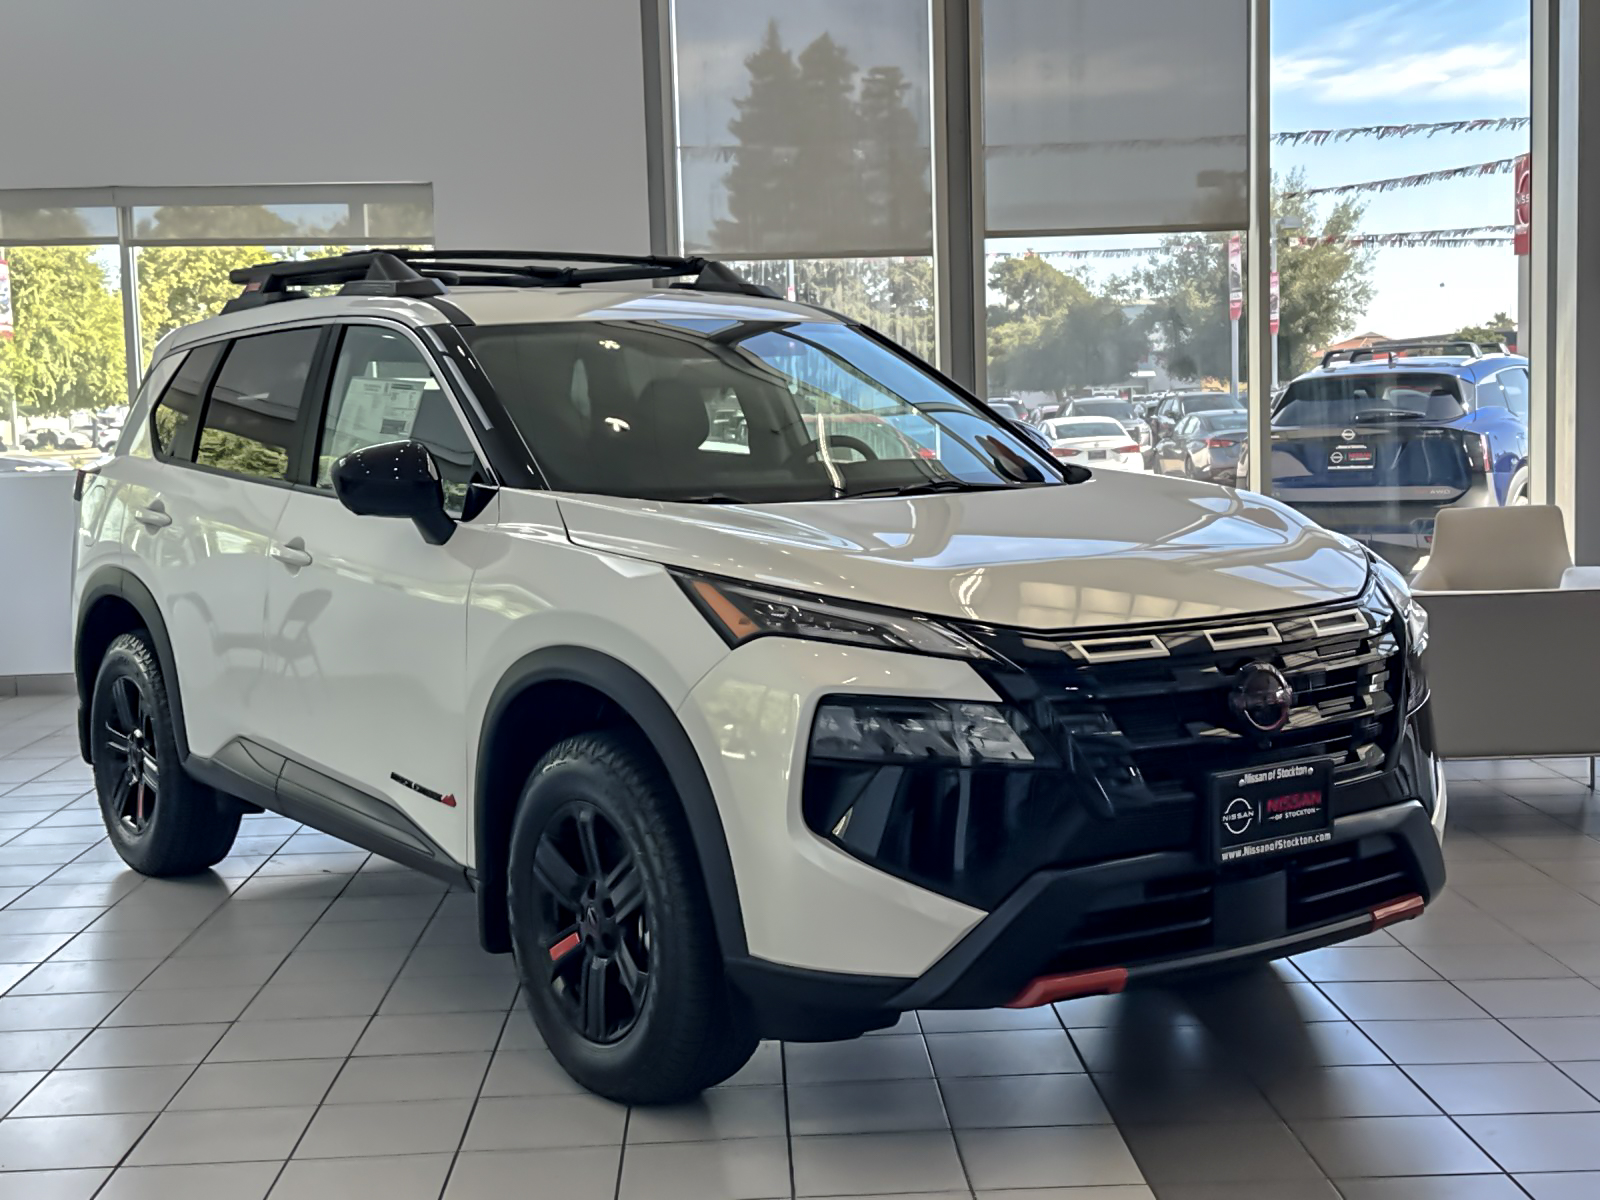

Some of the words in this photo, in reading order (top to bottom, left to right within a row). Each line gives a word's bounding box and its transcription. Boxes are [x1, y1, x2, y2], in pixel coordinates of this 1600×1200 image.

[1244, 772, 1268, 785] Nissan
[1268, 769, 1276, 780] of
[1276, 765, 1308, 779] Stockton
[1266, 790, 1322, 812] NISSAN
[1222, 810, 1255, 822] NISSAN
[1285, 807, 1316, 819] STOCKTON
[1221, 832, 1332, 861] www.NissanofStockton.com
